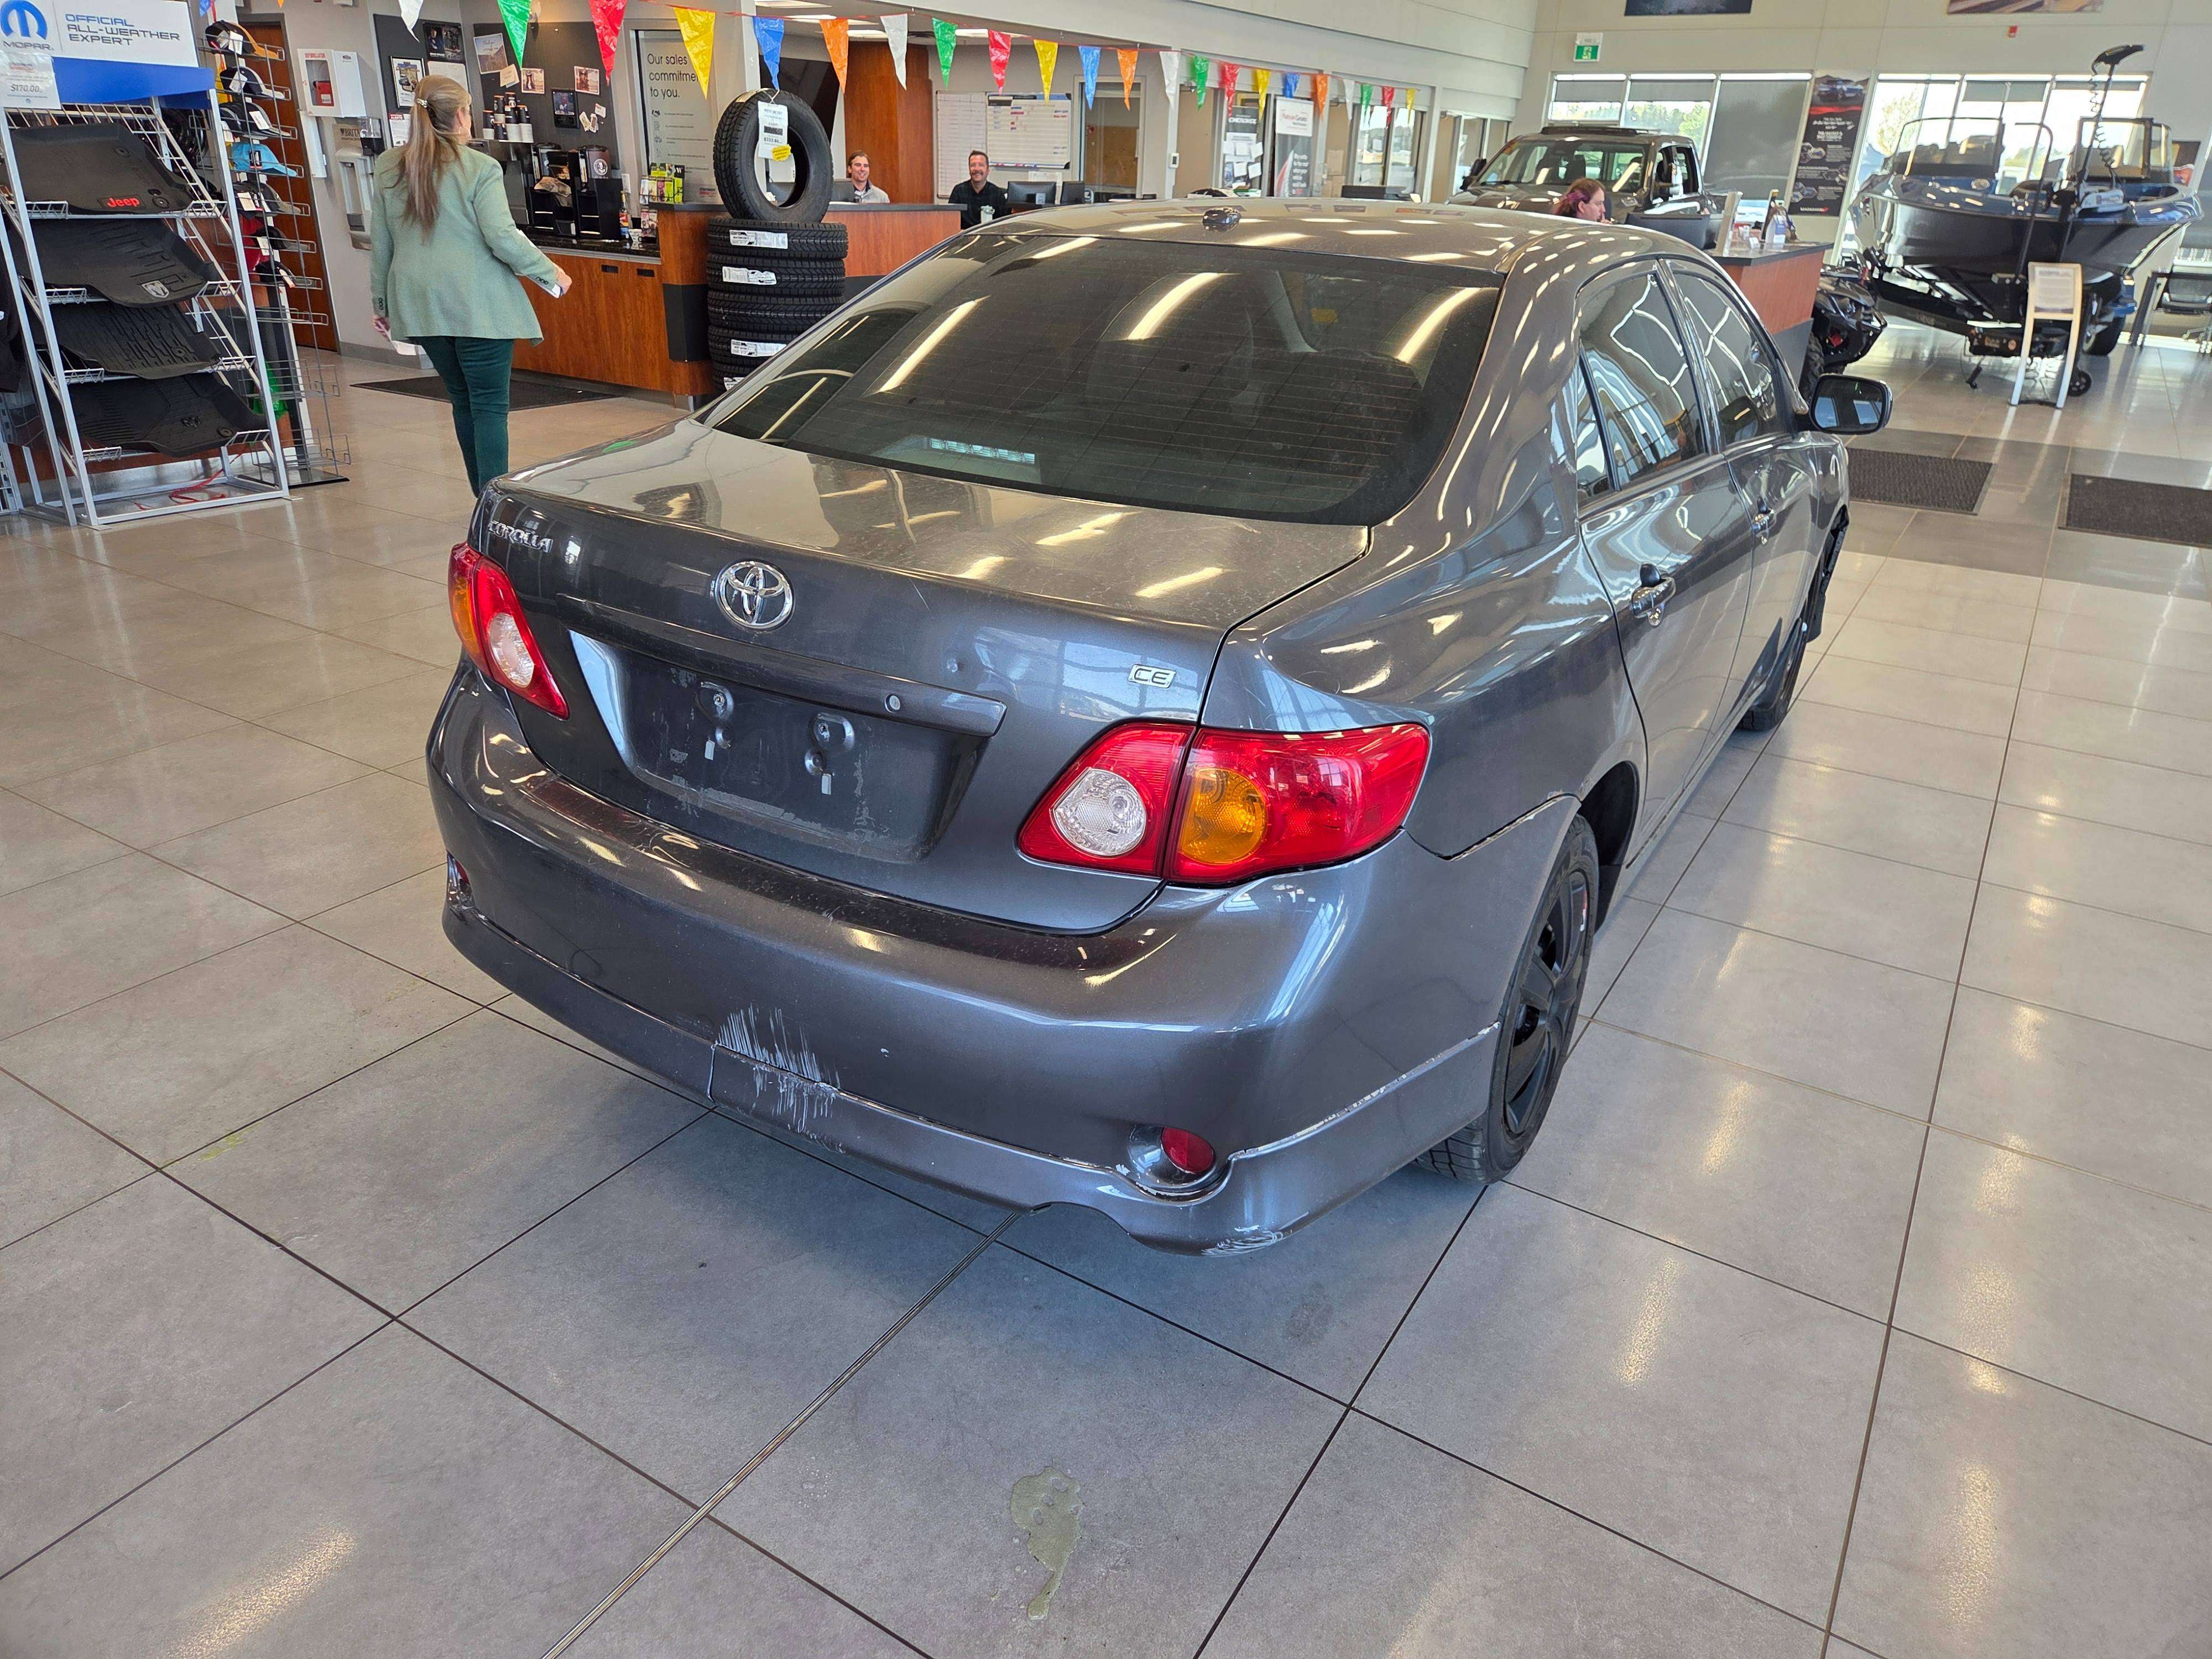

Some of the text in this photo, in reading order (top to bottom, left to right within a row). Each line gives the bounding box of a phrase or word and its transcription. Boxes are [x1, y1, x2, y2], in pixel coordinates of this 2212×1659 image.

[65, 14, 134, 27] OFFICIAL
[67, 24, 180, 41] ALL-WEATHER
[3, 40, 51, 50] MOPAR
[69, 34, 133, 46] EXPERT
[647, 53, 687, 65] Our sales
[649, 70, 699, 82] commitme
[11, 84, 40, 93] $170.00
[650, 86, 680, 100] to you.
[107, 196, 140, 207] Jeep
[487, 520, 554, 553] COROLLA
[1134, 667, 1170, 685] CE
